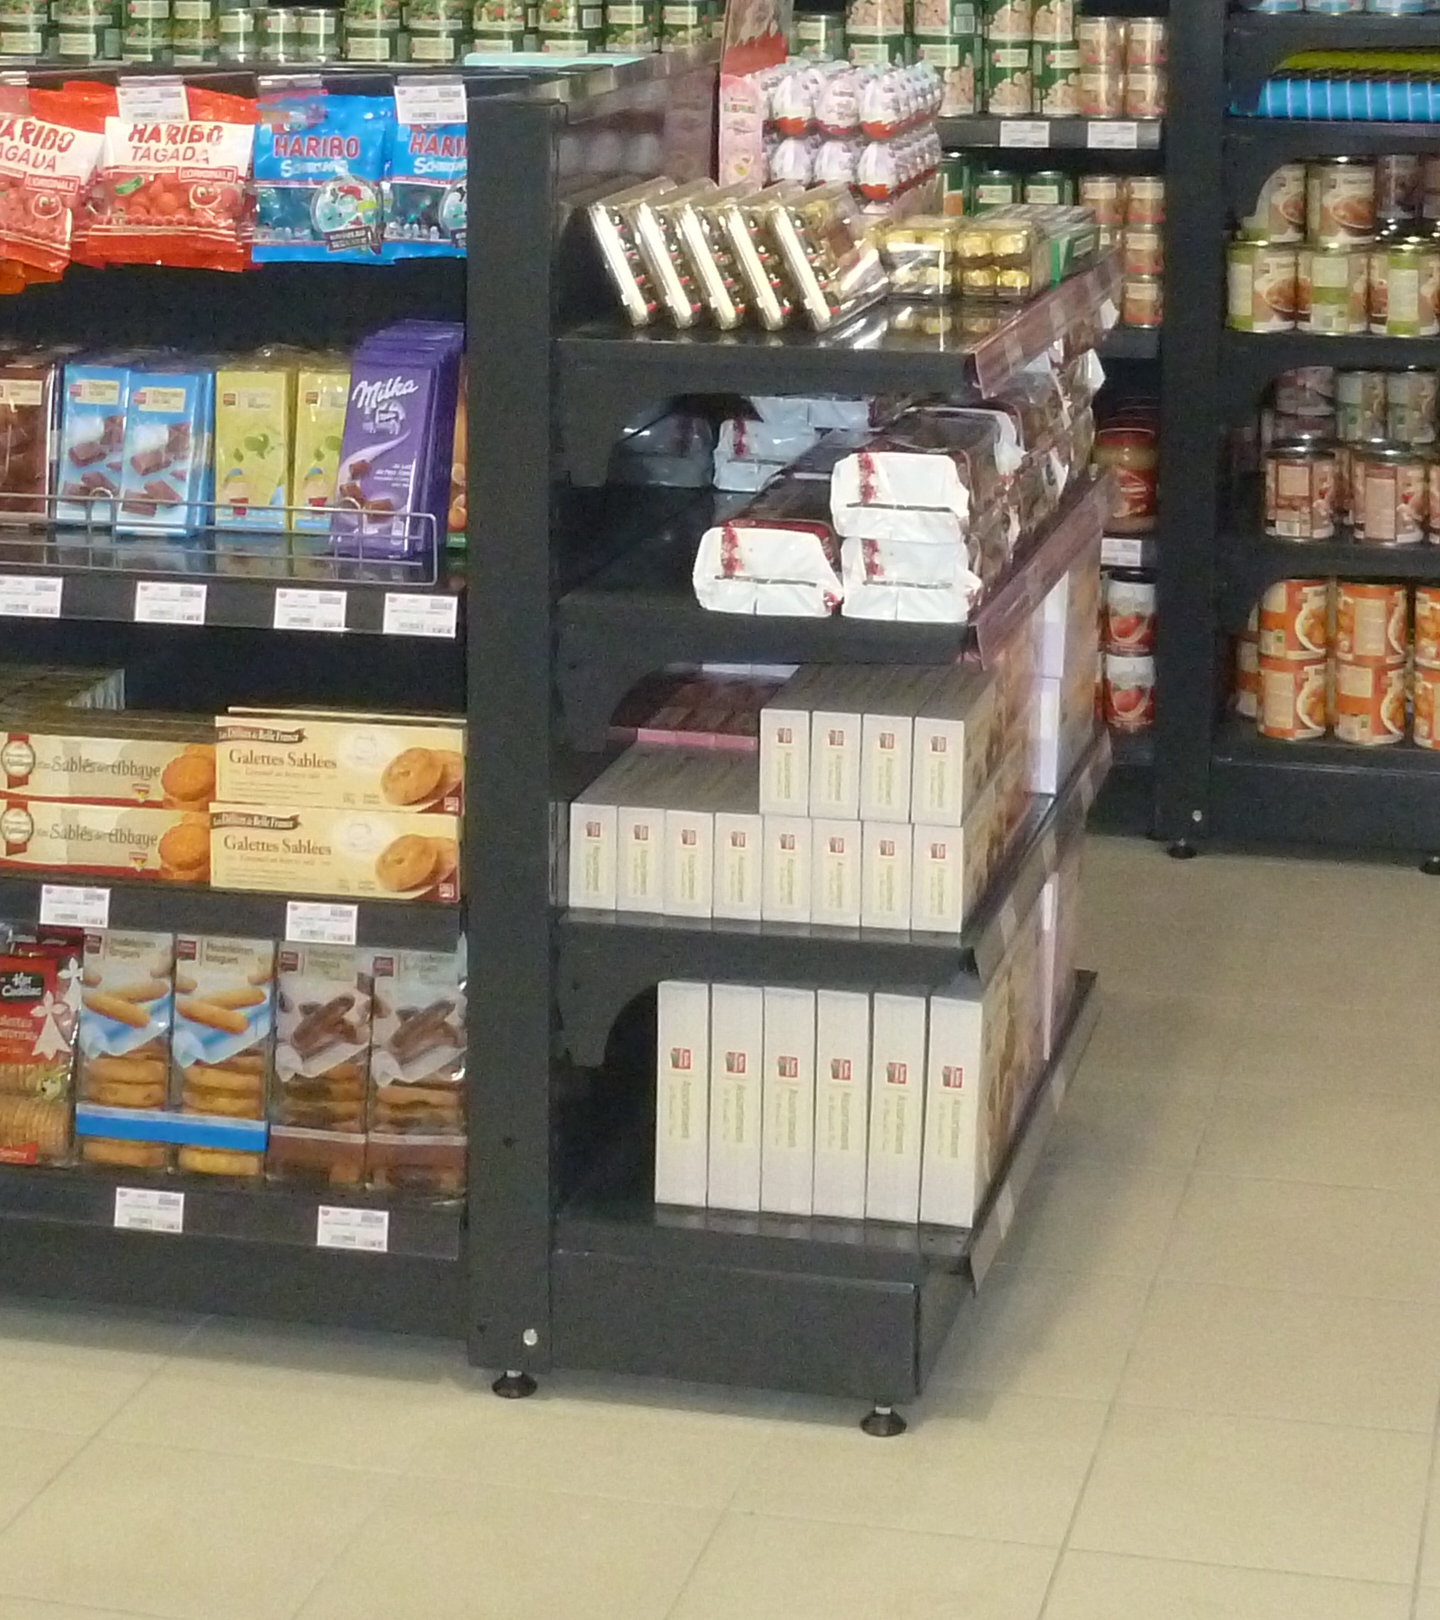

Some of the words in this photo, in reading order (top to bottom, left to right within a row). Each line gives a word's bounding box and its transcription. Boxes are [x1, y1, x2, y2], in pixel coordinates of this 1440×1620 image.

[127, 123, 224, 145] HARIBO
[130, 145, 210, 165] TAGADA
[273, 135, 360, 158] HARIBO
[352, 376, 419, 408] Milka
[229, 749, 284, 767] Galettes
[224, 835, 279, 853] Galettes
